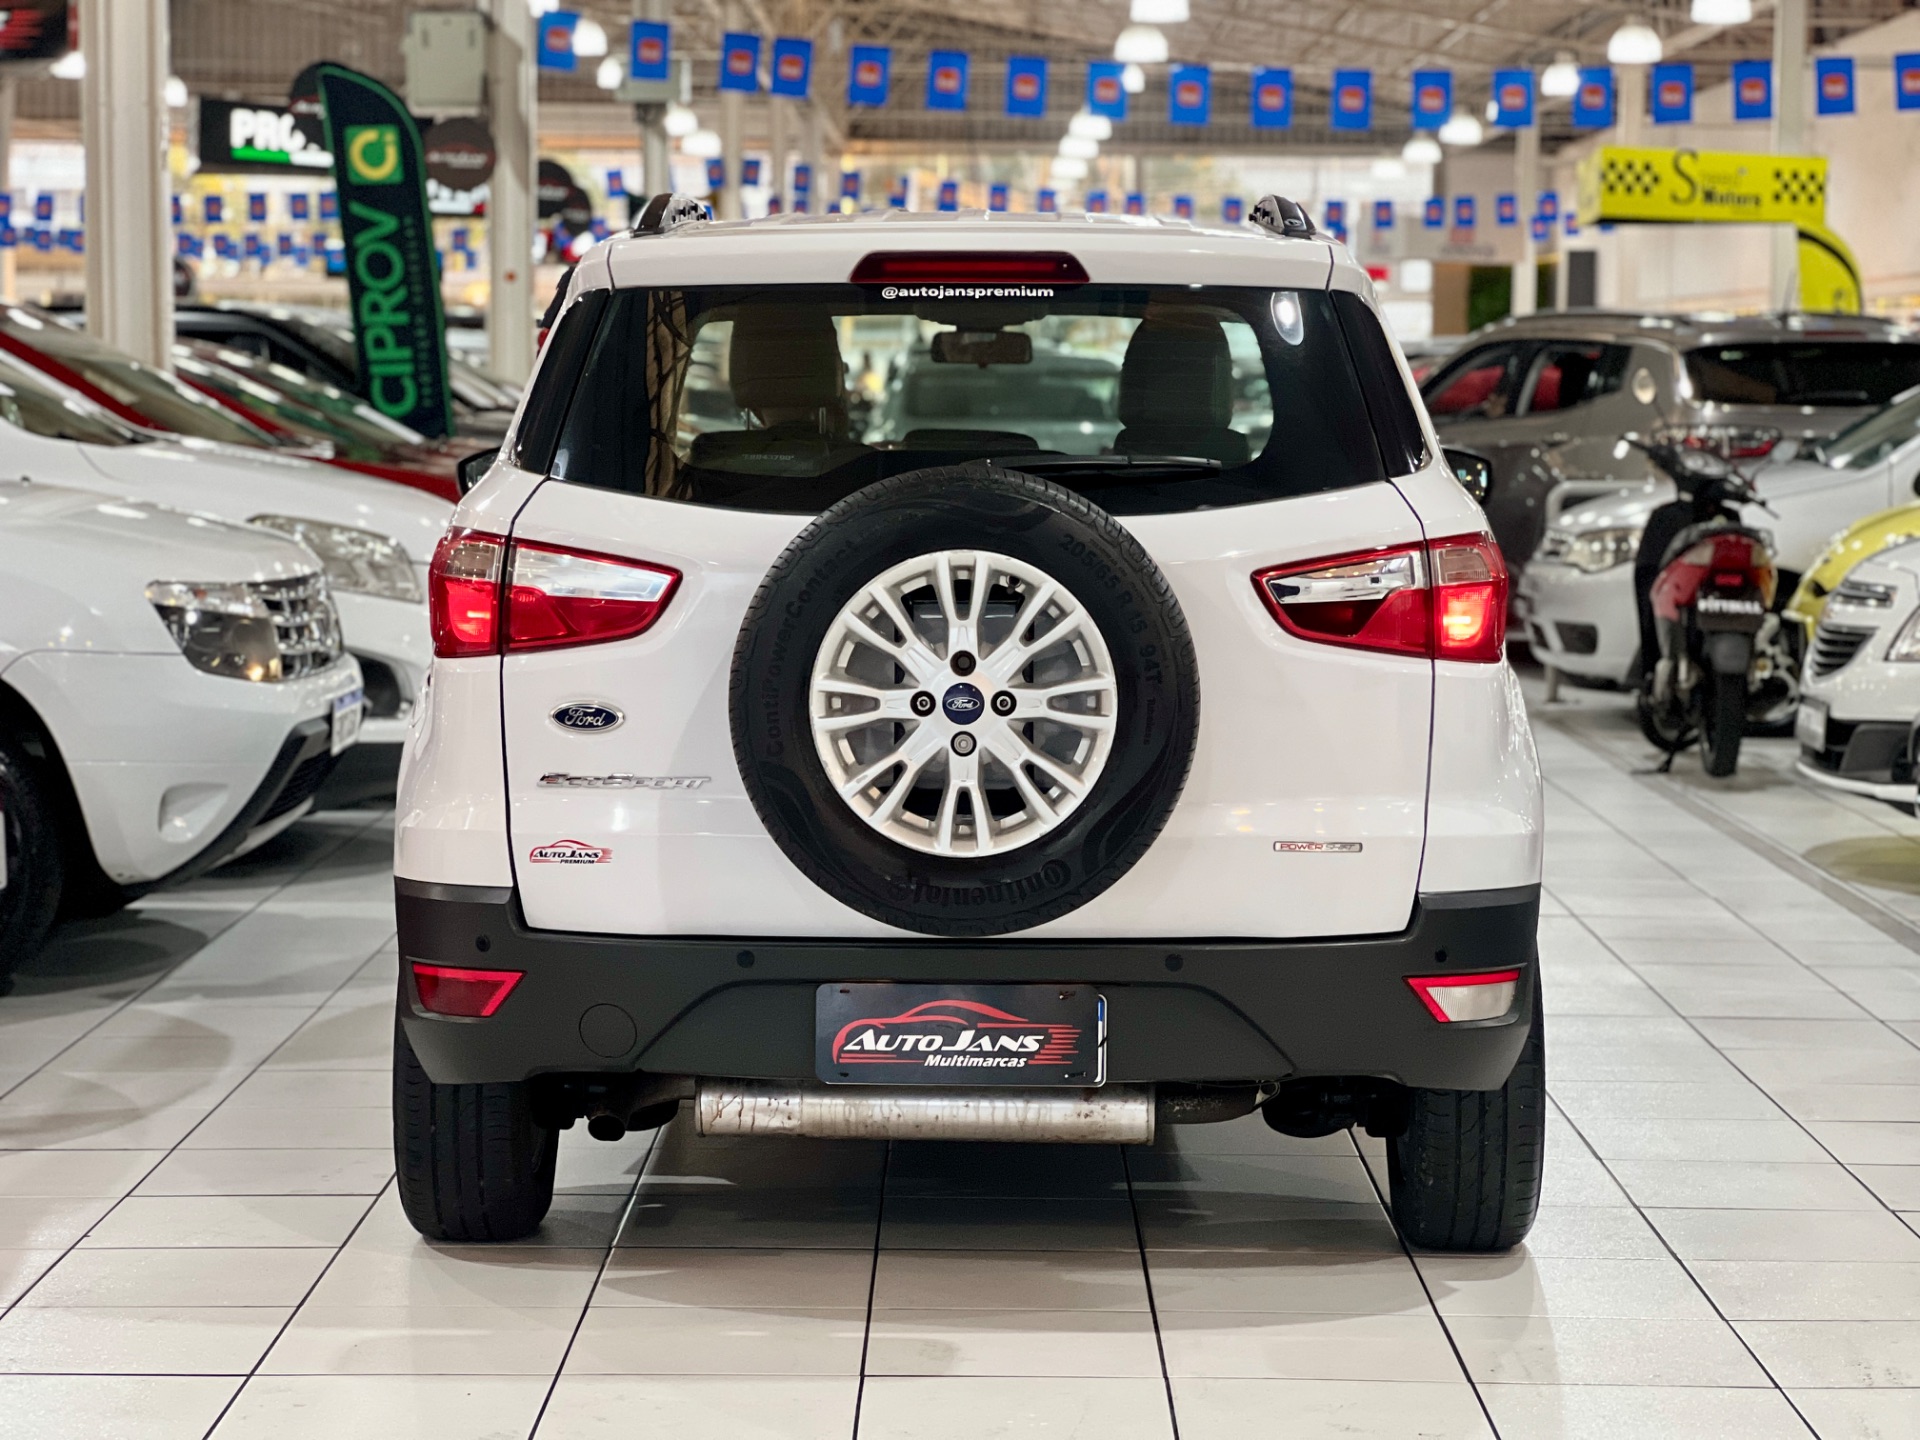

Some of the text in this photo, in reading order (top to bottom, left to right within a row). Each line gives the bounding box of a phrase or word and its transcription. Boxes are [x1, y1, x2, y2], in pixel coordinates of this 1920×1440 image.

[881, 285, 1054, 299] @autojanspremium
[350, 201, 417, 418] CIPROV
[565, 707, 606, 727] Ford
[924, 1054, 1027, 1067] Multimarcas
